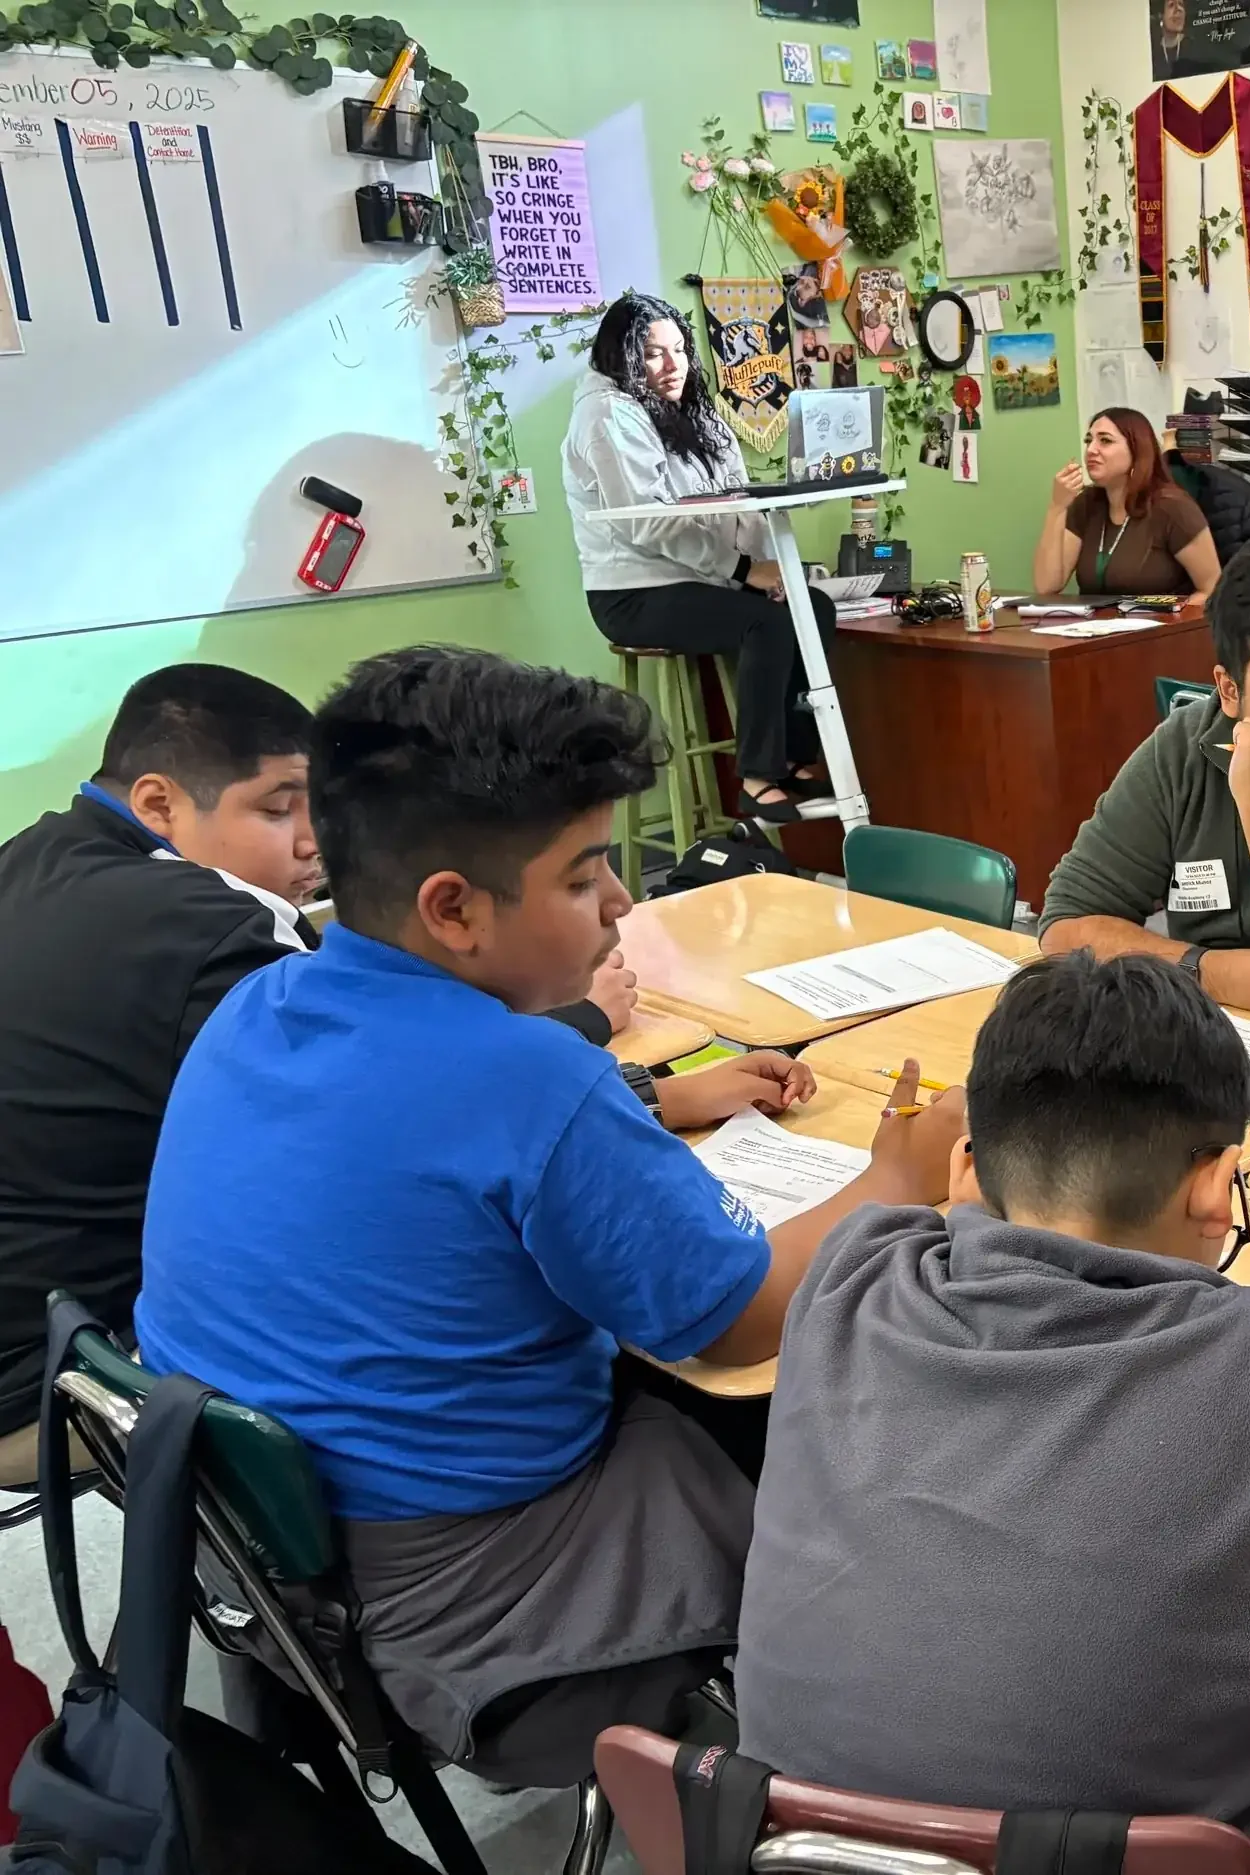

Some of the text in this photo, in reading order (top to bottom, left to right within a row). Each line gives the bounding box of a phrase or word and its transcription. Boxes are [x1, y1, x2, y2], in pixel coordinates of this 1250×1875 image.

[146, 83, 215, 111] 2025
[1, 117, 42, 136] Mustang
[73, 128, 117, 147] Warning
[162, 137, 177, 147] and
[148, 147, 175, 157] Contact
[489, 155, 563, 175] TBH, BRO,
[493, 173, 560, 190] IT'S LIKE
[495, 191, 575, 208] SO CRINGE
[1140, 200, 1161, 211] CLASS
[498, 209, 581, 226] WHEN YOU
[500, 227, 580, 243] FORGET TO
[503, 245, 571, 260] WRITE IN
[506, 262, 586, 277] COMPLETE
[509, 279, 596, 294] SENTENCES.
[722, 356, 781, 386] Hufflepuff
[1185, 865, 1213, 873] VISITOR
